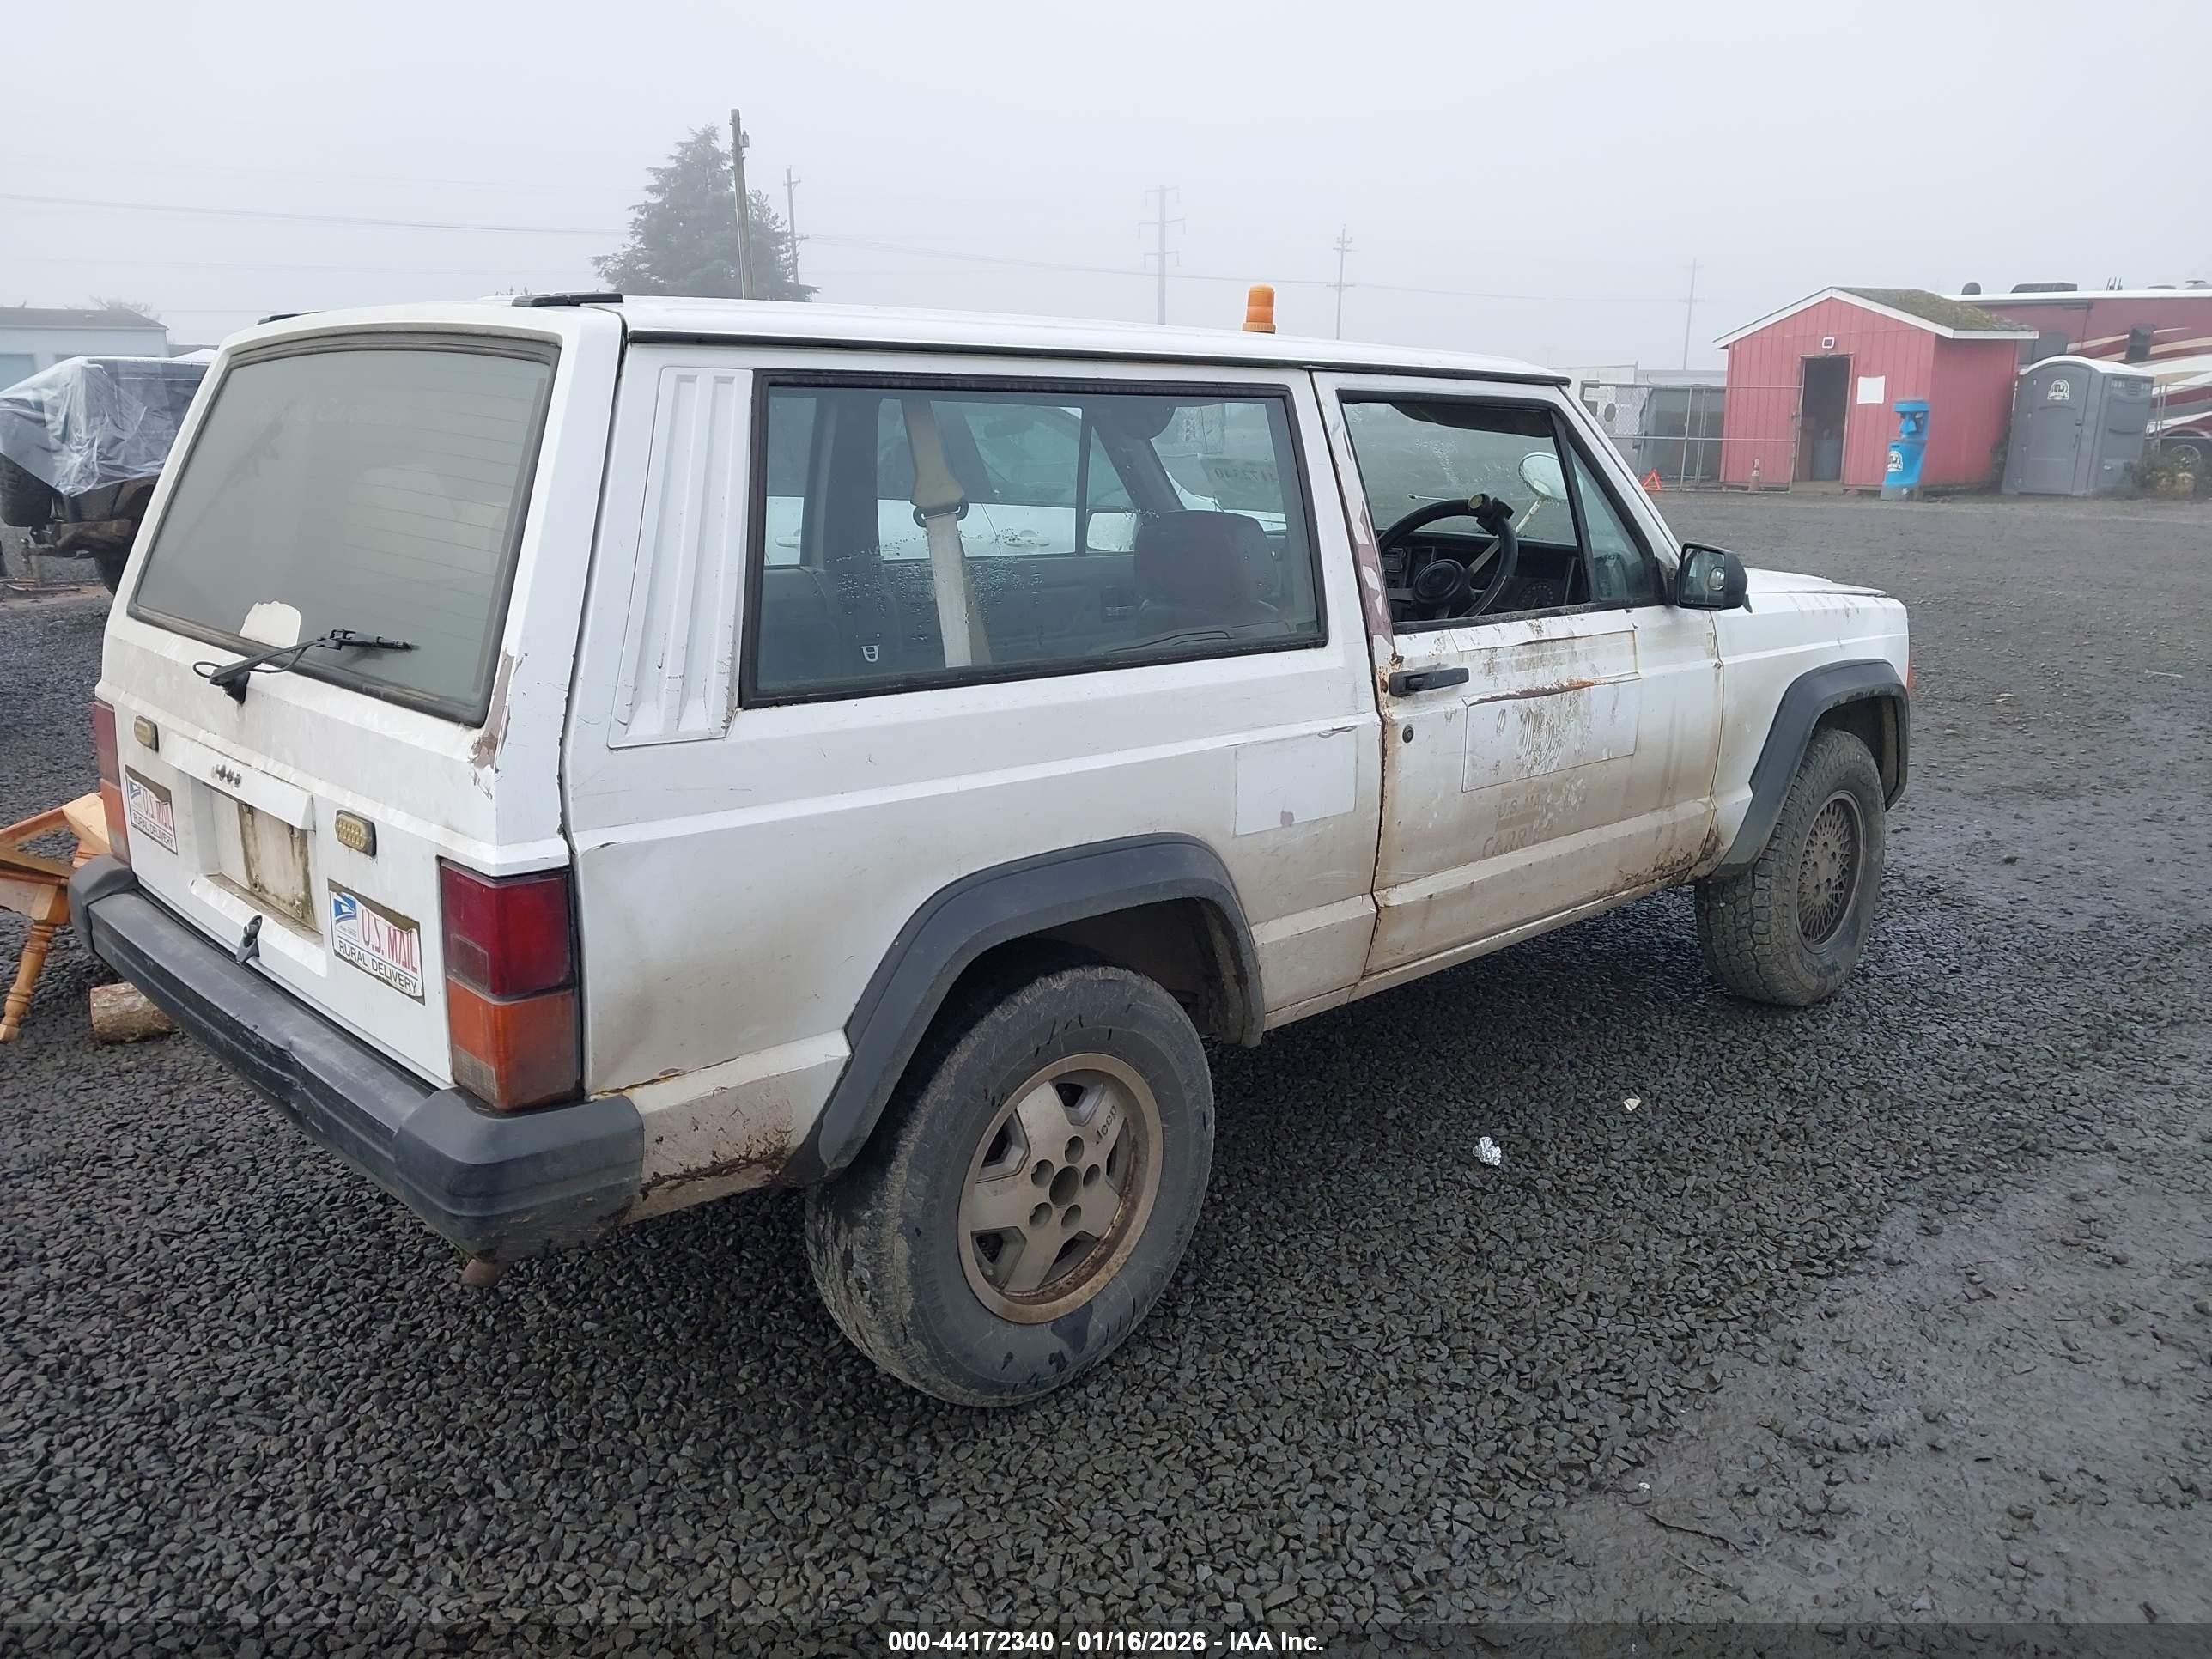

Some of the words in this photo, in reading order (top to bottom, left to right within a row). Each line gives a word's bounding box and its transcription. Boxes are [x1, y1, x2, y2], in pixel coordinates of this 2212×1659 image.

[133, 812, 149, 833] RURAL
[150, 823, 173, 848] DELIVERY
[338, 940, 368, 969] RURAL
[371, 957, 417, 994] DELIVERY
[386, 925, 418, 975] MAIL
